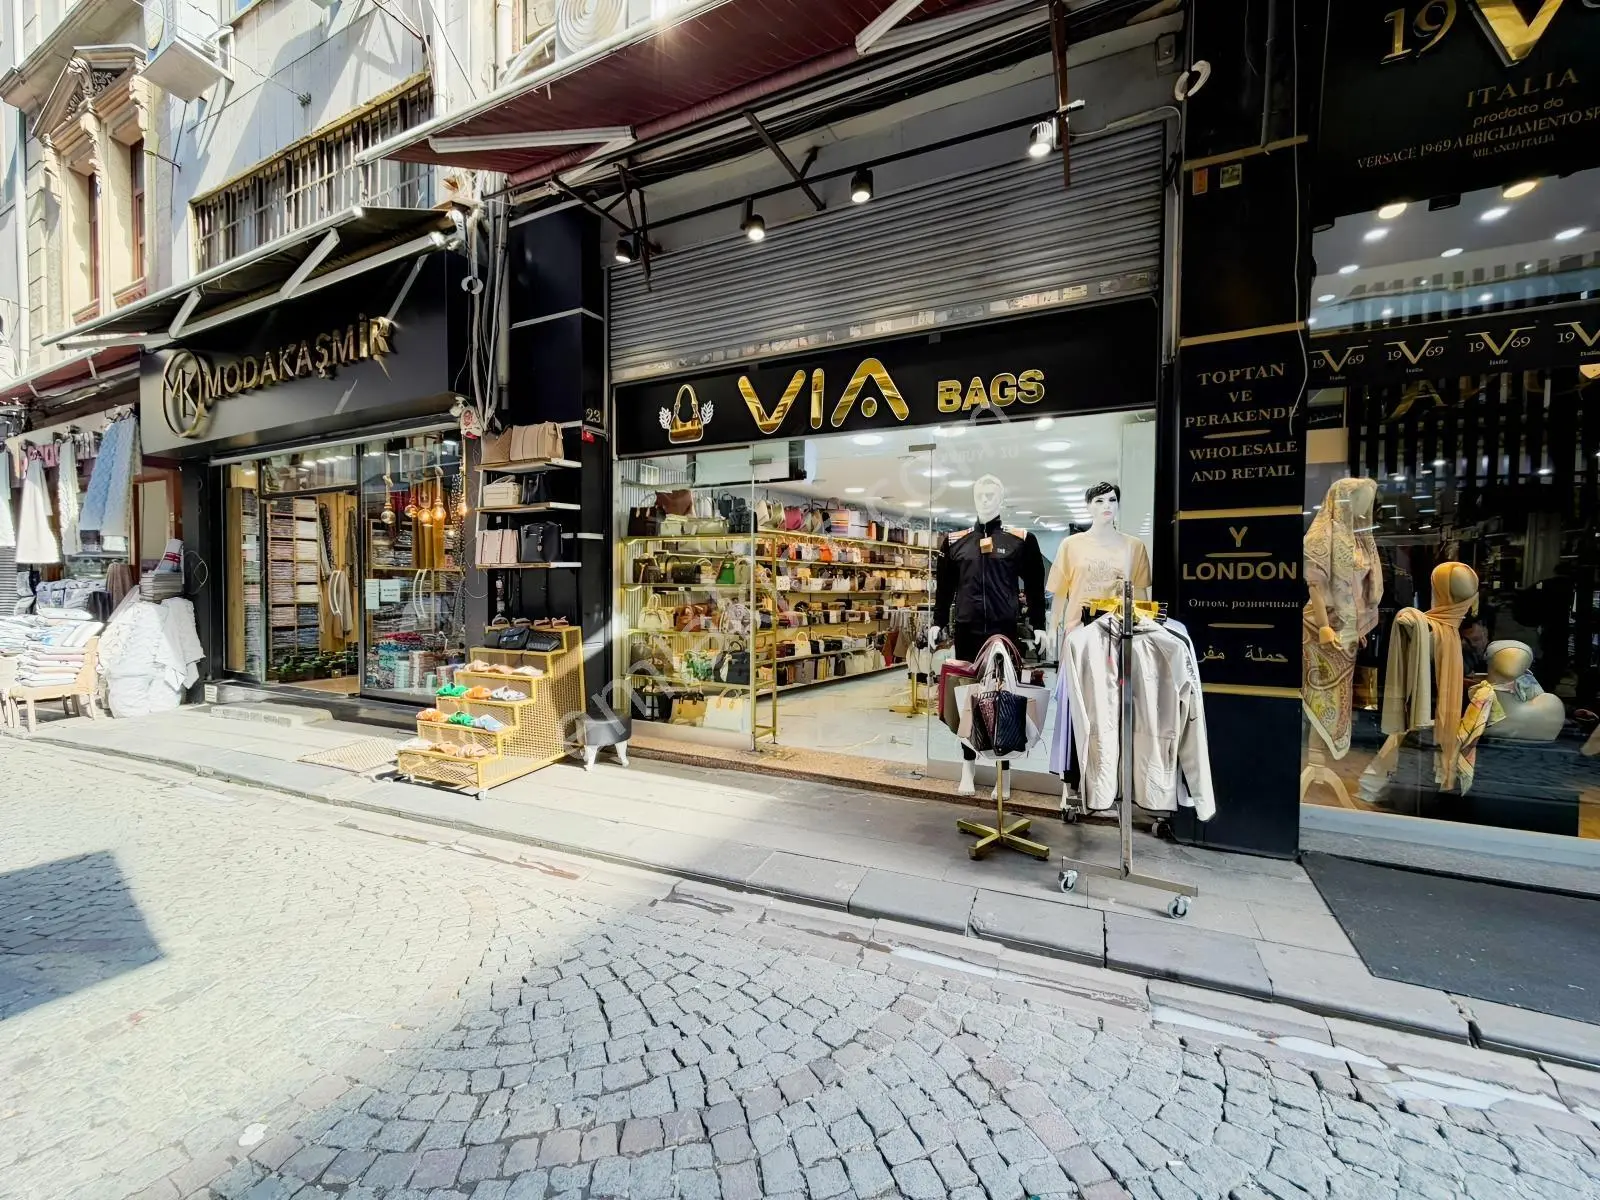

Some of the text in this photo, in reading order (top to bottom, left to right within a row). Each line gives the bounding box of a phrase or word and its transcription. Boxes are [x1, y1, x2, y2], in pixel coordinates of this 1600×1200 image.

[1467, 67, 1579, 108] ITALIA
[1473, 104, 1539, 128] prodotto
[1358, 146, 1417, 168] VERSACE
[204, 313, 390, 399] MODAKAŞMİR
[1196, 363, 1285, 386] TOPTAN
[737, 357, 1045, 434] VIA BAGS
[1228, 390, 1253, 403] VE
[585, 408, 600, 423] 23
[1189, 441, 1298, 461] WHOLESALE
[1191, 465, 1295, 483] AND RETAIL
[1229, 526, 1248, 547] Y
[1182, 561, 1297, 581] LONDON
